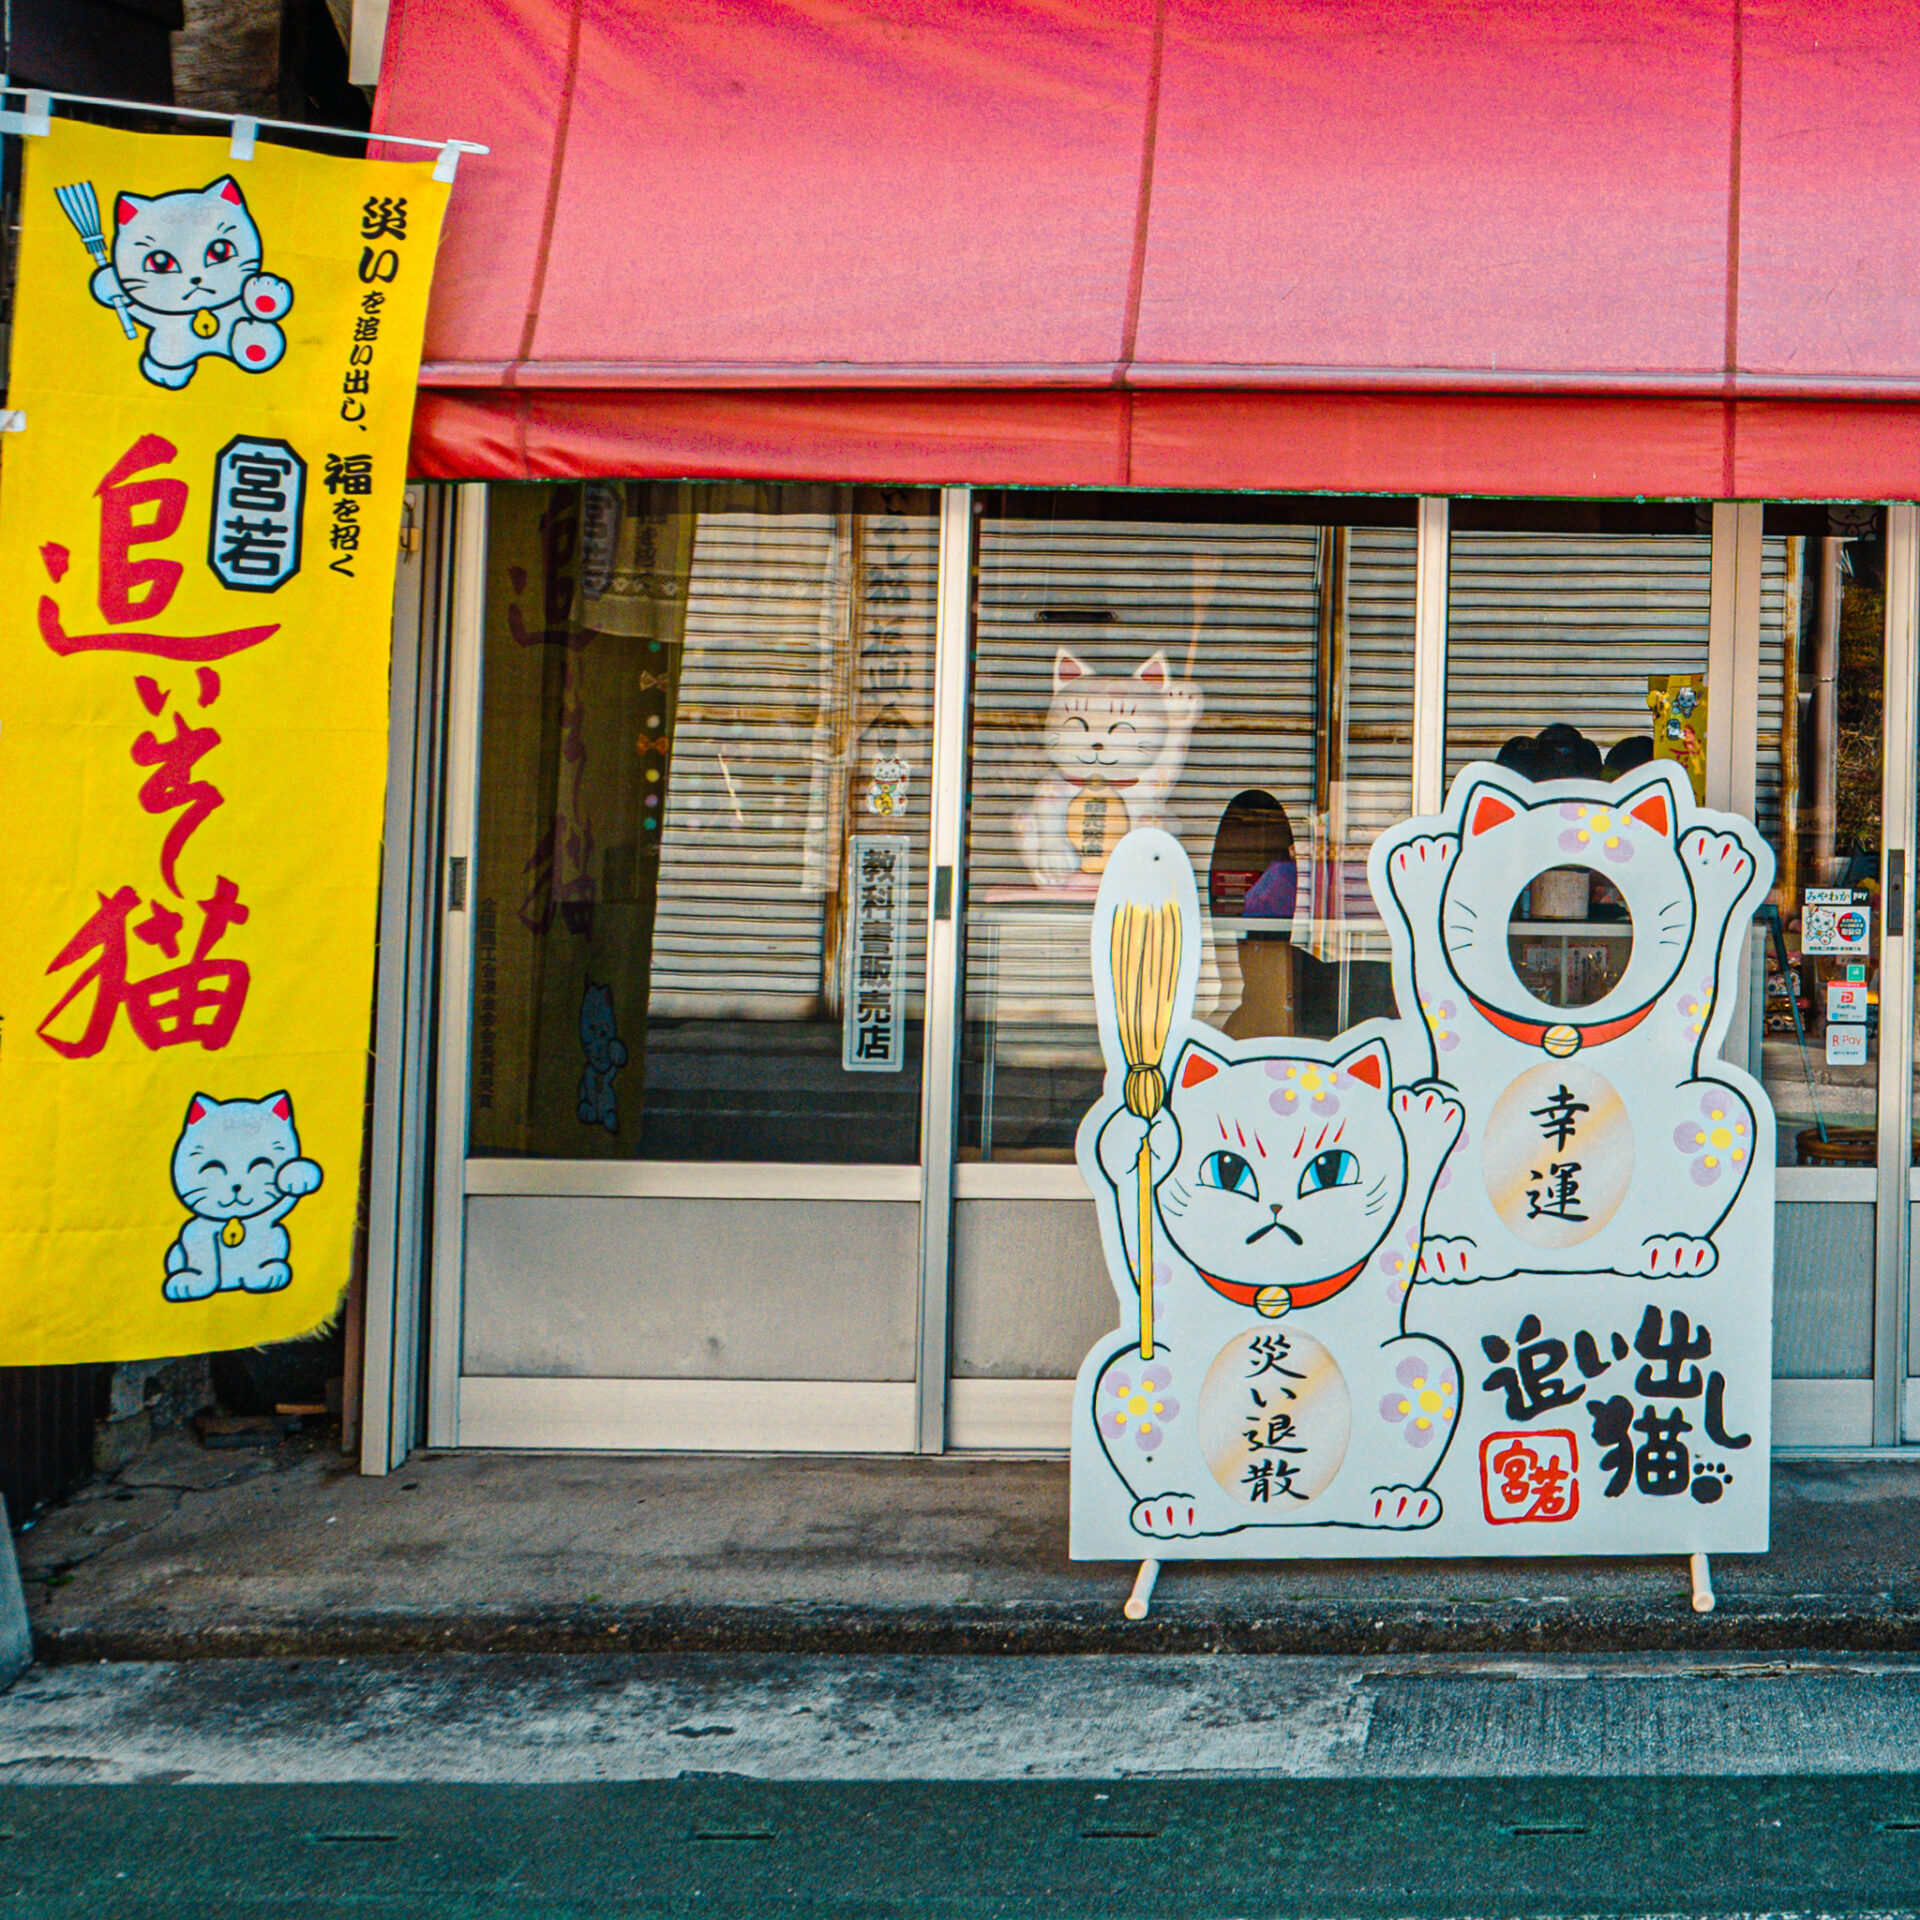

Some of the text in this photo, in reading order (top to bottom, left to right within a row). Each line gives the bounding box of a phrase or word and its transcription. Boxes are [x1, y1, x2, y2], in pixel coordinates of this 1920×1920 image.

[322, 196, 408, 578] 災いを追い出し、福を招く
[219, 451, 292, 578] 宮若
[855, 848, 897, 1061] 教科書販売店
[1525, 1083, 1590, 1222] 幸運
[1240, 1333, 1310, 1503] 災い退散
[1493, 1438, 1570, 1517] 宮若
